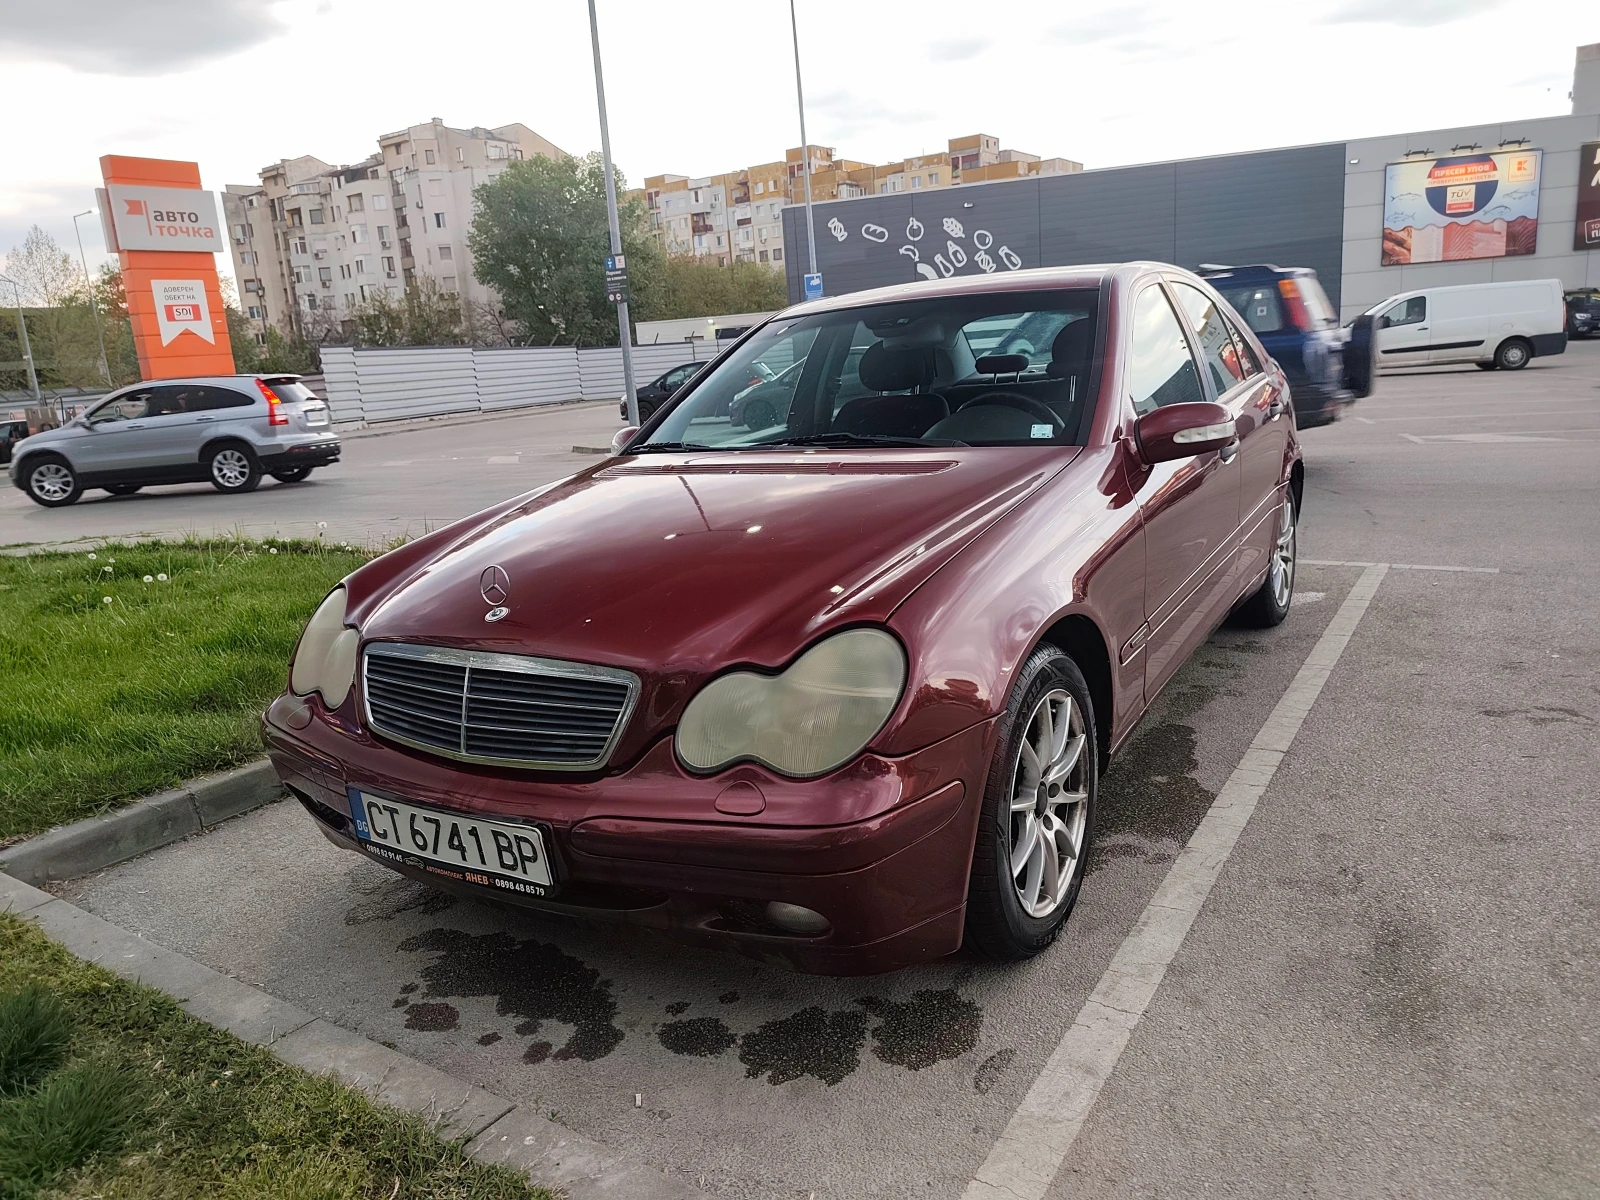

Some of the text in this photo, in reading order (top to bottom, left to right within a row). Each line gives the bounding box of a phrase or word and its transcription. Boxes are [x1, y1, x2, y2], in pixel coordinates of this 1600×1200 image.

[1434, 164, 1490, 177] ПРЕСЕН УЛОВ
[1428, 174, 1496, 185] ПРОВЕРЕНО КАЧЕСТВО
[153, 209, 199, 223] авто
[156, 224, 214, 238] точка
[175, 308, 192, 316] SDI
[356, 819, 369, 833] BG
[366, 801, 538, 876] CT 6741 BP
[465, 872, 489, 885] ЯНЕВ
[495, 878, 515, 890] 0898
[515, 882, 525, 892] 48
[525, 884, 535, 894] 85
[535, 886, 545, 896] 79
